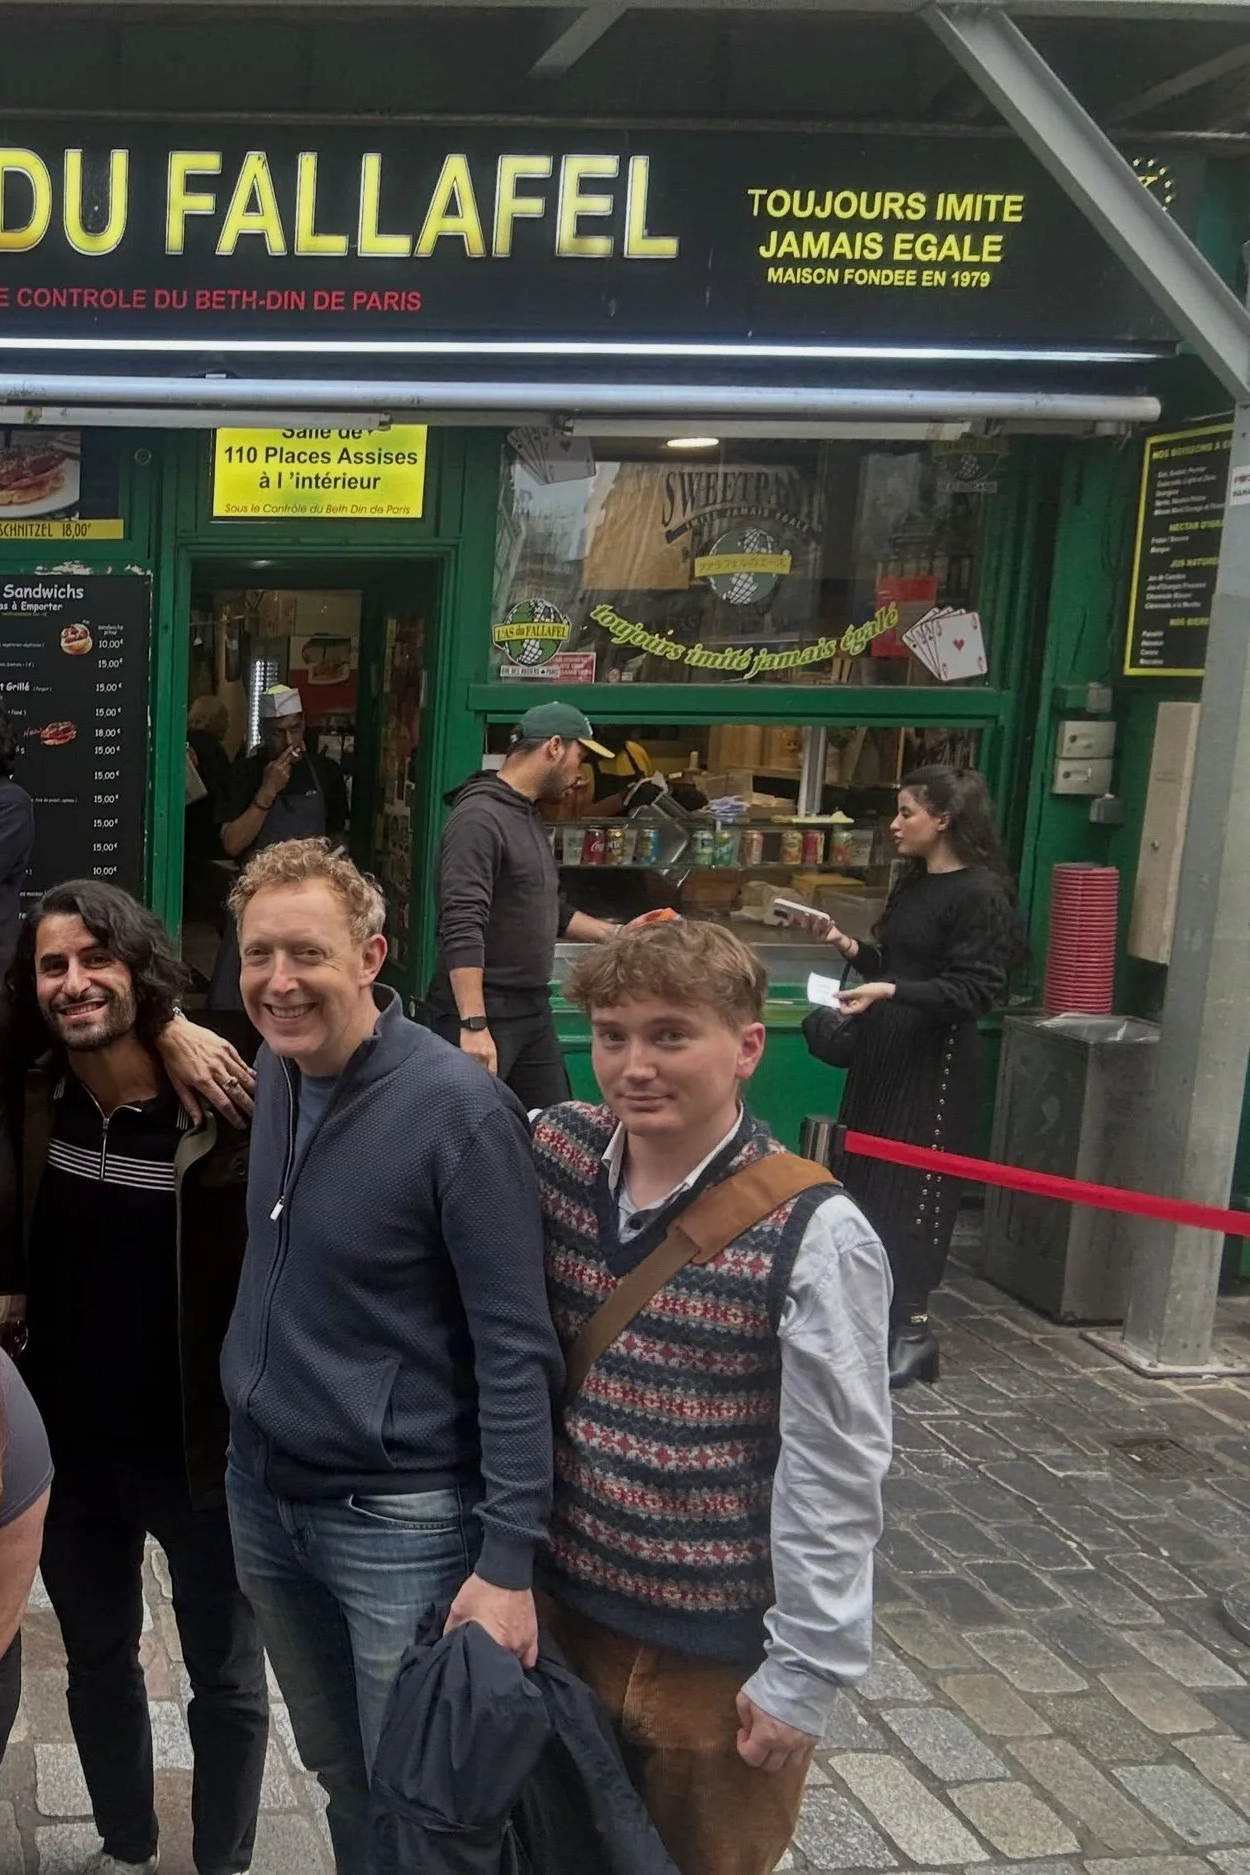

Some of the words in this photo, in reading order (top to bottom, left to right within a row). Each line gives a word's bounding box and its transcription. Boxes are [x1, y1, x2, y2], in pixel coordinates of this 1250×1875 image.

[165, 151, 679, 260] FALLAFEL
[748, 188, 926, 221] TOUJOURS
[936, 193, 1025, 223] IMITE
[759, 231, 883, 260] JAMAIS
[893, 233, 1003, 263] EGALE
[767, 266, 839, 285] MAISON
[844, 269, 917, 287] FONDEE
[922, 270, 946, 288] EN
[950, 270, 991, 288] 1979
[16, 288, 147, 309] CONTROLE
[154, 289, 188, 309] DU
[195, 289, 305, 311] BETH-DIN
[313, 291, 345, 311] DE
[353, 291, 422, 312] PARIS
[224, 446, 258, 464] 110
[265, 446, 332, 465] Places
[337, 447, 418, 466] Assises
[259, 472, 270, 489] à
[225, 503, 248, 514] Sous
[251, 504, 260, 514] le
[263, 503, 307, 514] Contrôle
[310, 504, 323, 514] du
[325, 504, 349, 515] Beth
[351, 504, 367, 515] Din
[370, 504, 384, 515] de
[386, 504, 410, 515] Paris
[726, 507, 770, 518] JAMAIS
[3, 584, 84, 599] Sandwichs
[12, 601, 17, 611] à
[21, 602, 63, 613] Emporter
[526, 624, 567, 638] FALLAFEL
[590, 603, 686, 660] toujours
[684, 643, 752, 671] imité
[743, 637, 836, 680] jamais
[840, 602, 899, 655] égalé
[6, 681, 30, 692] Grillé
